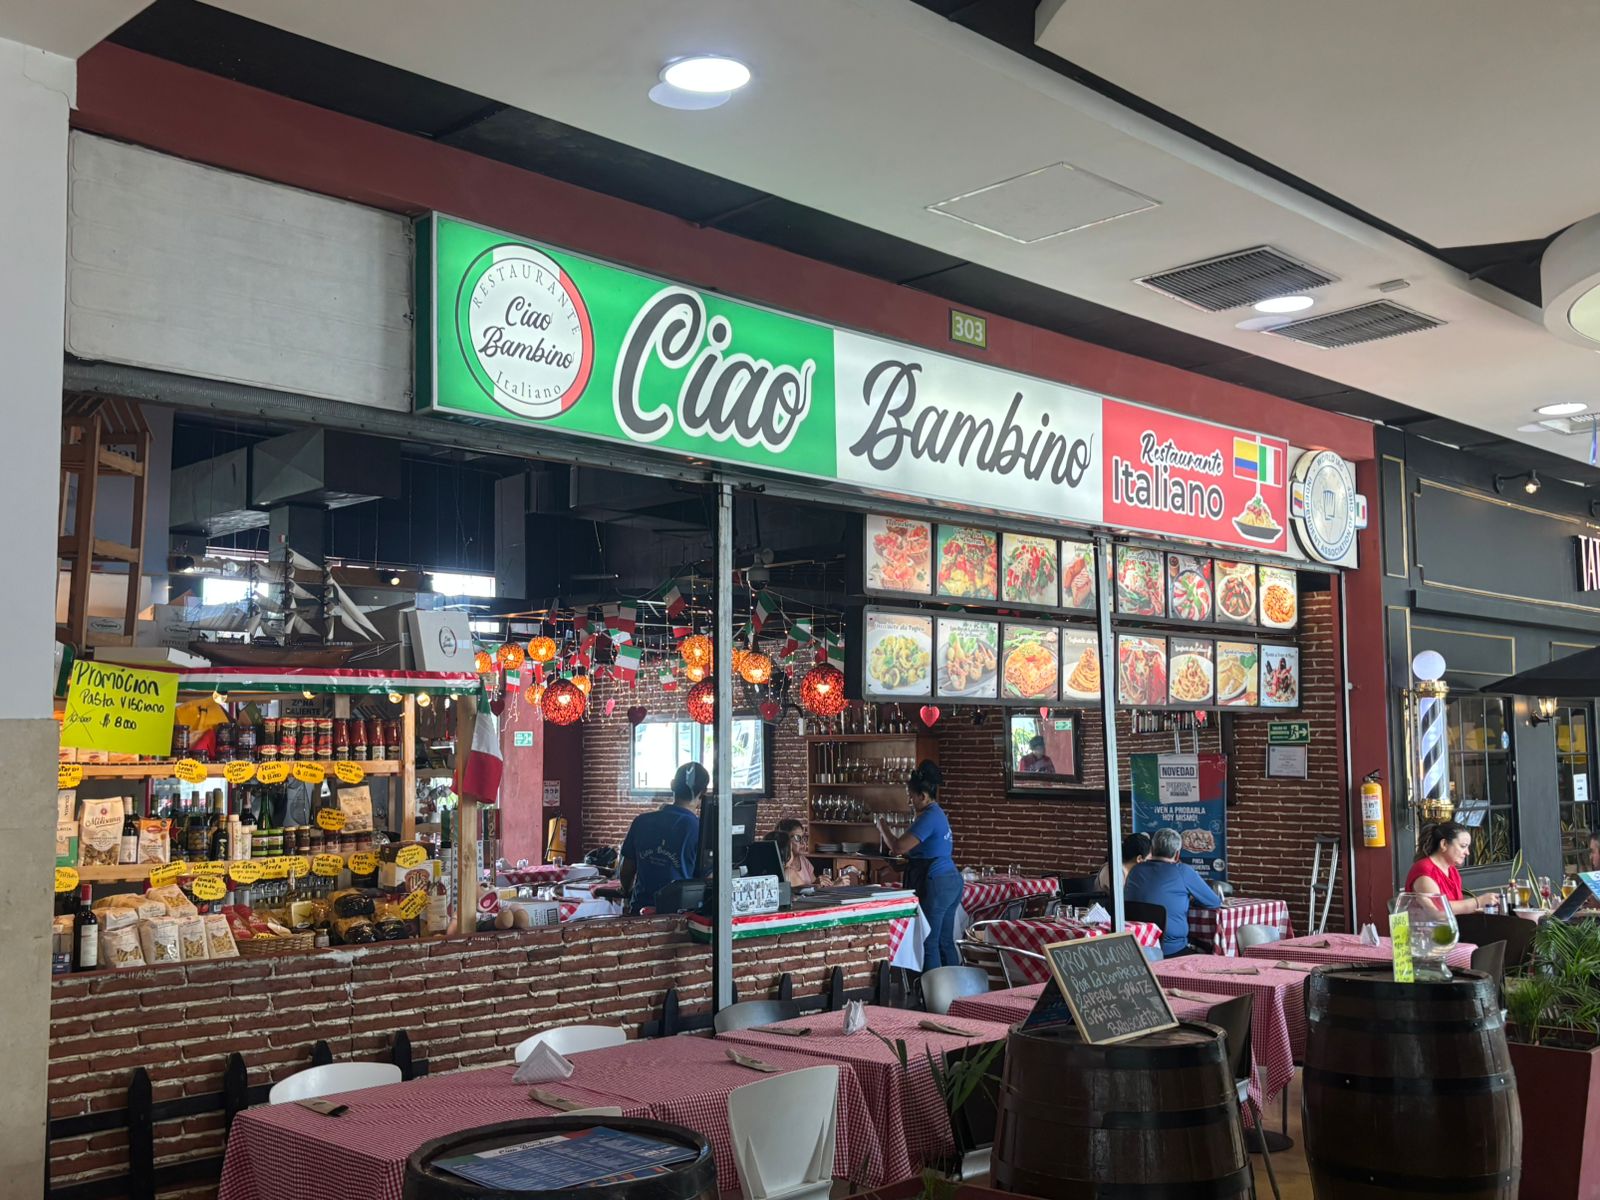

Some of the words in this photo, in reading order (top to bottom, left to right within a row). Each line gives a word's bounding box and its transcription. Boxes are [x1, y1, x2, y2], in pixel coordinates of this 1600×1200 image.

[473, 263, 581, 336] RESTAURANTE
[504, 296, 553, 332] Ciao
[953, 314, 985, 344] 303
[478, 326, 574, 370] Bambino
[493, 370, 562, 400] Italiano
[614, 289, 815, 449] Ciao
[848, 359, 1093, 489] Bambino
[1142, 431, 1223, 474] Restaurante
[1113, 459, 1224, 518] Italiano
[1319, 530, 1352, 558] ASSOCIATION
[80, 688, 115, 708] Pasta
[1162, 767, 1195, 777] NOVEDAD
[1169, 806, 1174, 814] A
[1174, 807, 1206, 815] PROBARLA
